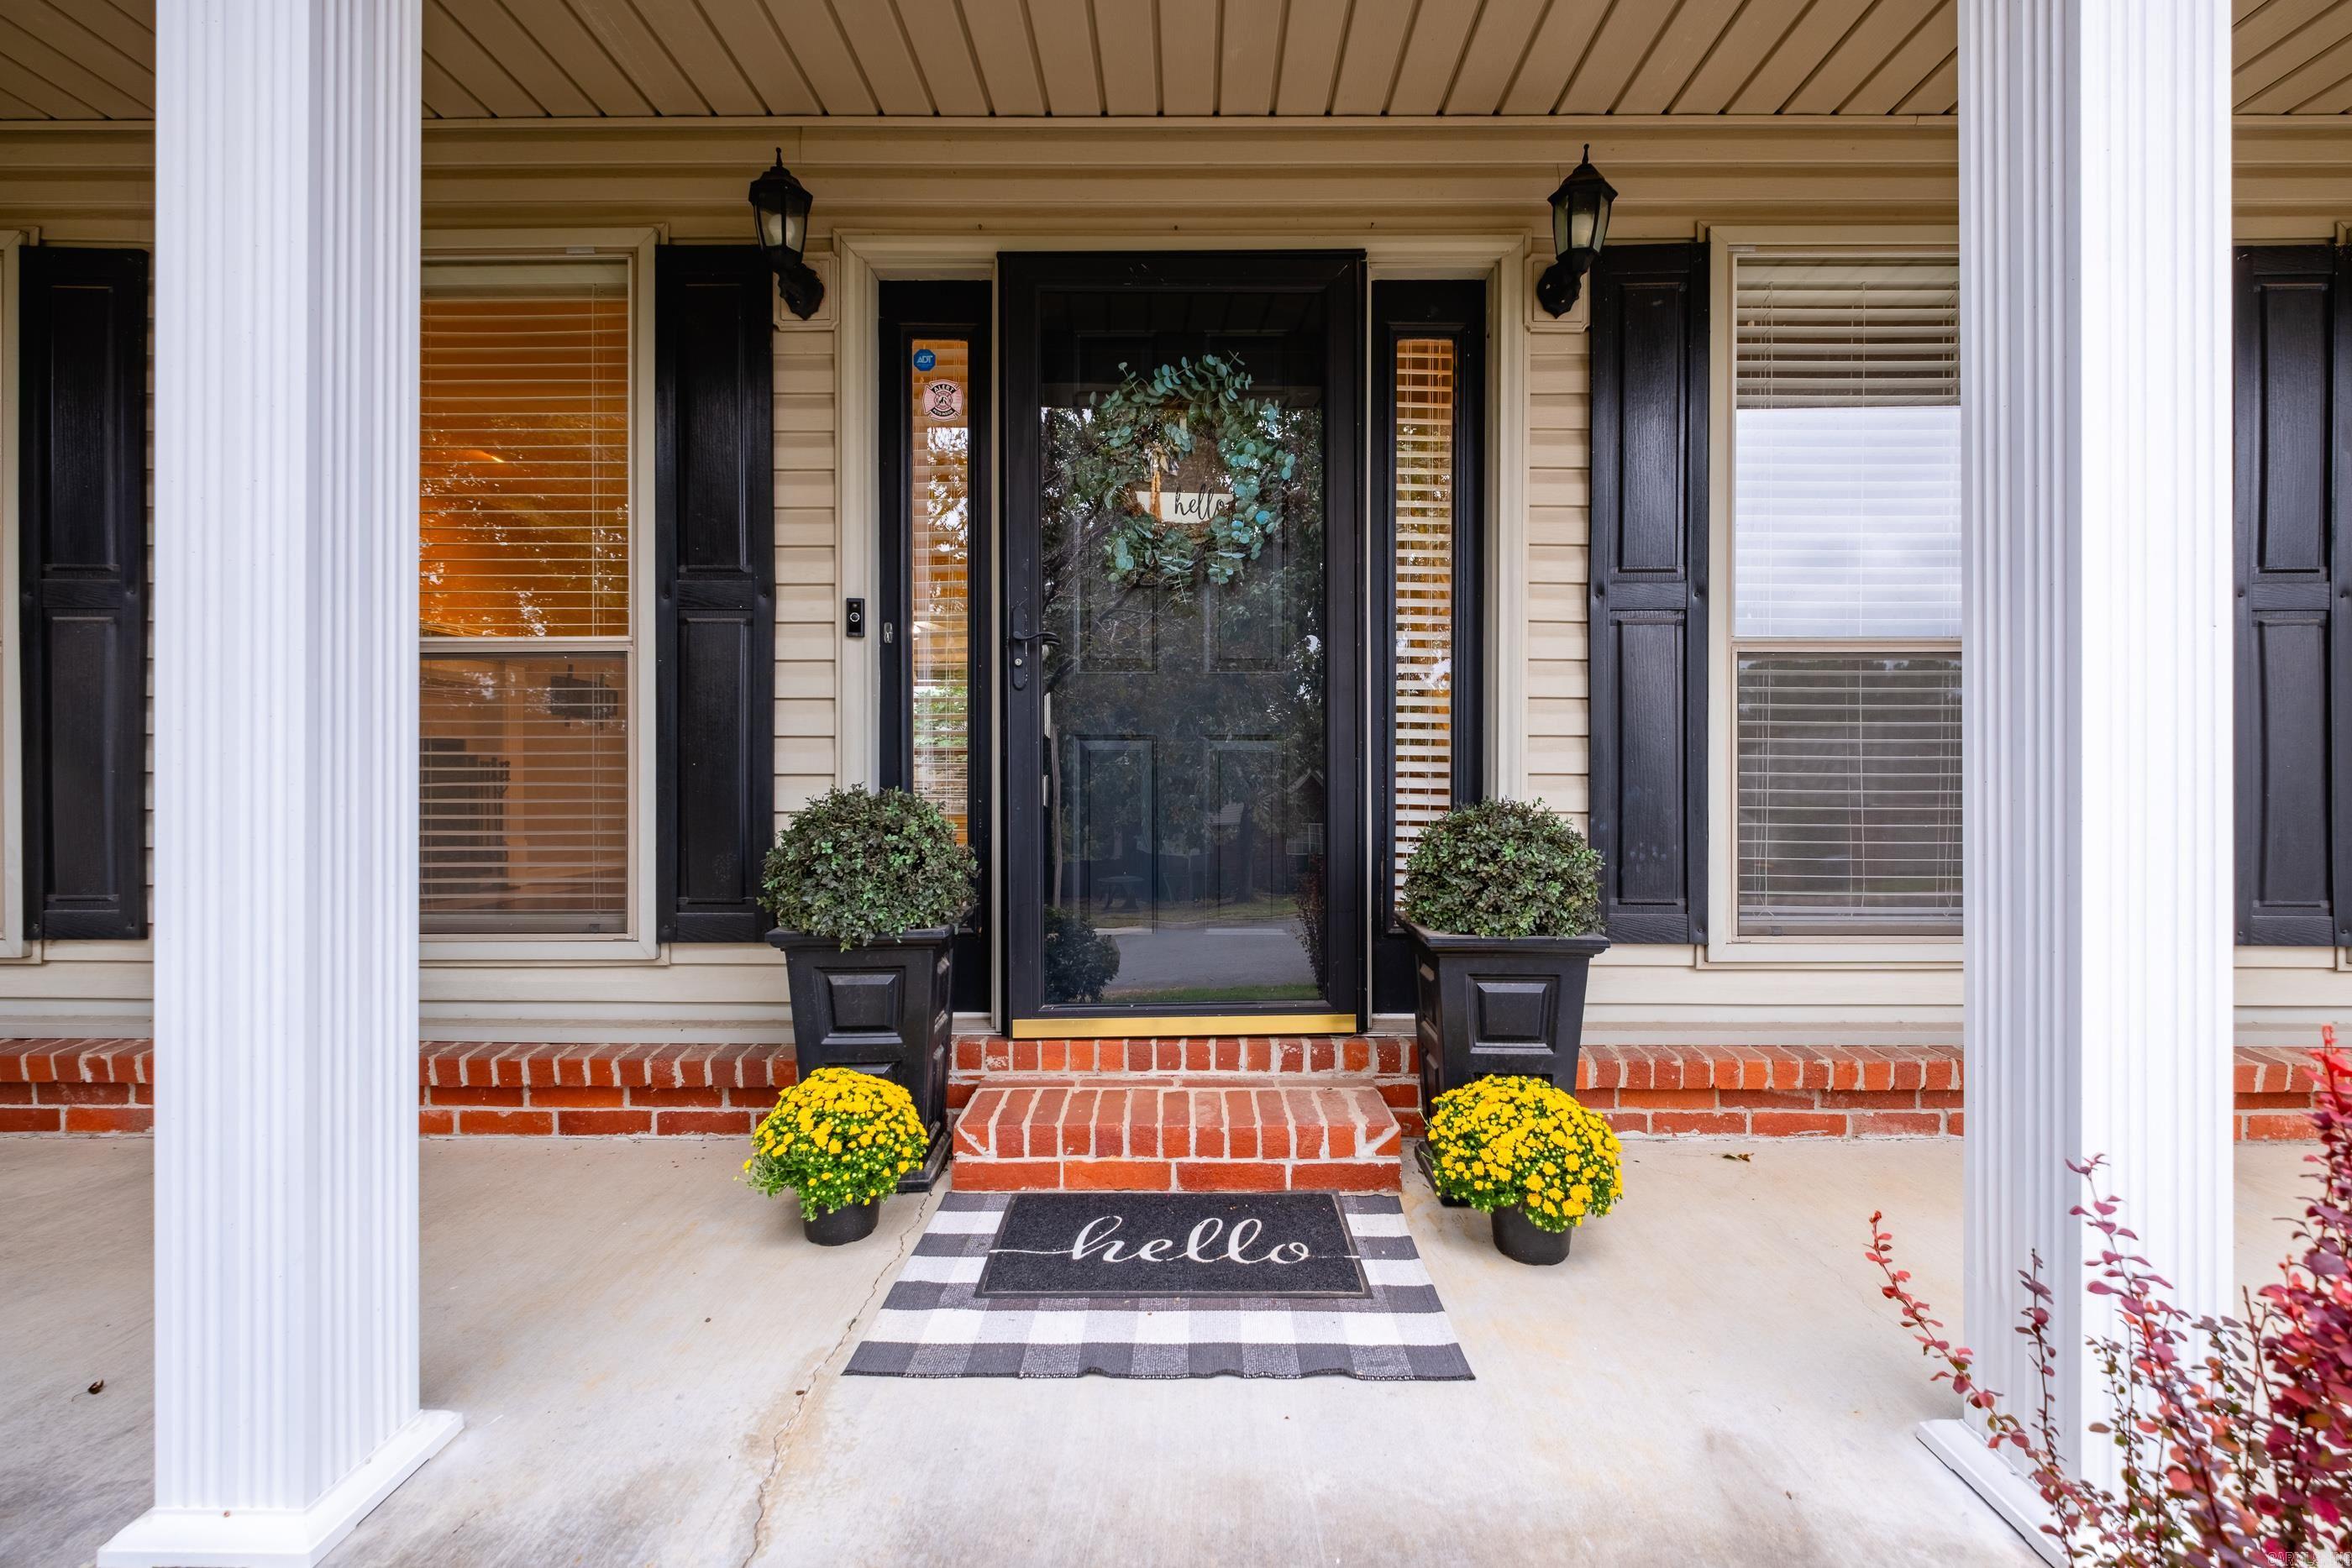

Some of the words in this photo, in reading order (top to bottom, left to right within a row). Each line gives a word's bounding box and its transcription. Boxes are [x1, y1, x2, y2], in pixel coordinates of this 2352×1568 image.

[916, 355, 933, 364] ADT
[933, 384, 954, 392] ALERT
[1173, 483, 1226, 521] hello
[1071, 1214, 1310, 1265] hello
